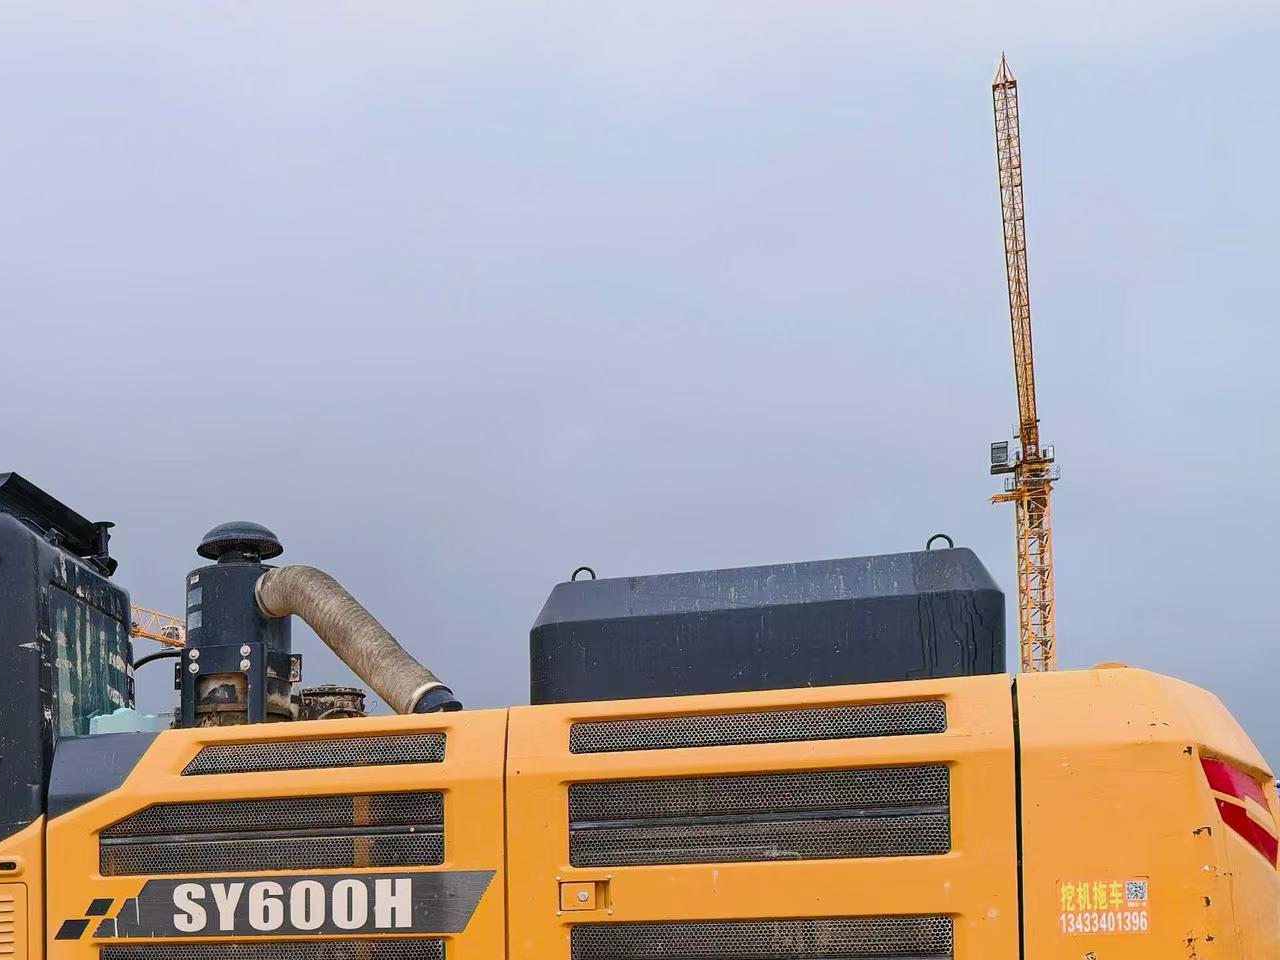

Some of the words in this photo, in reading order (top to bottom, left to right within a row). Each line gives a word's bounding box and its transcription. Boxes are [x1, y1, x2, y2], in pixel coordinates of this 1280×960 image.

[173, 878, 412, 933] SY600H
[1060, 879, 1123, 911] 挖机拖车
[1060, 910, 1148, 933] 13433401396
